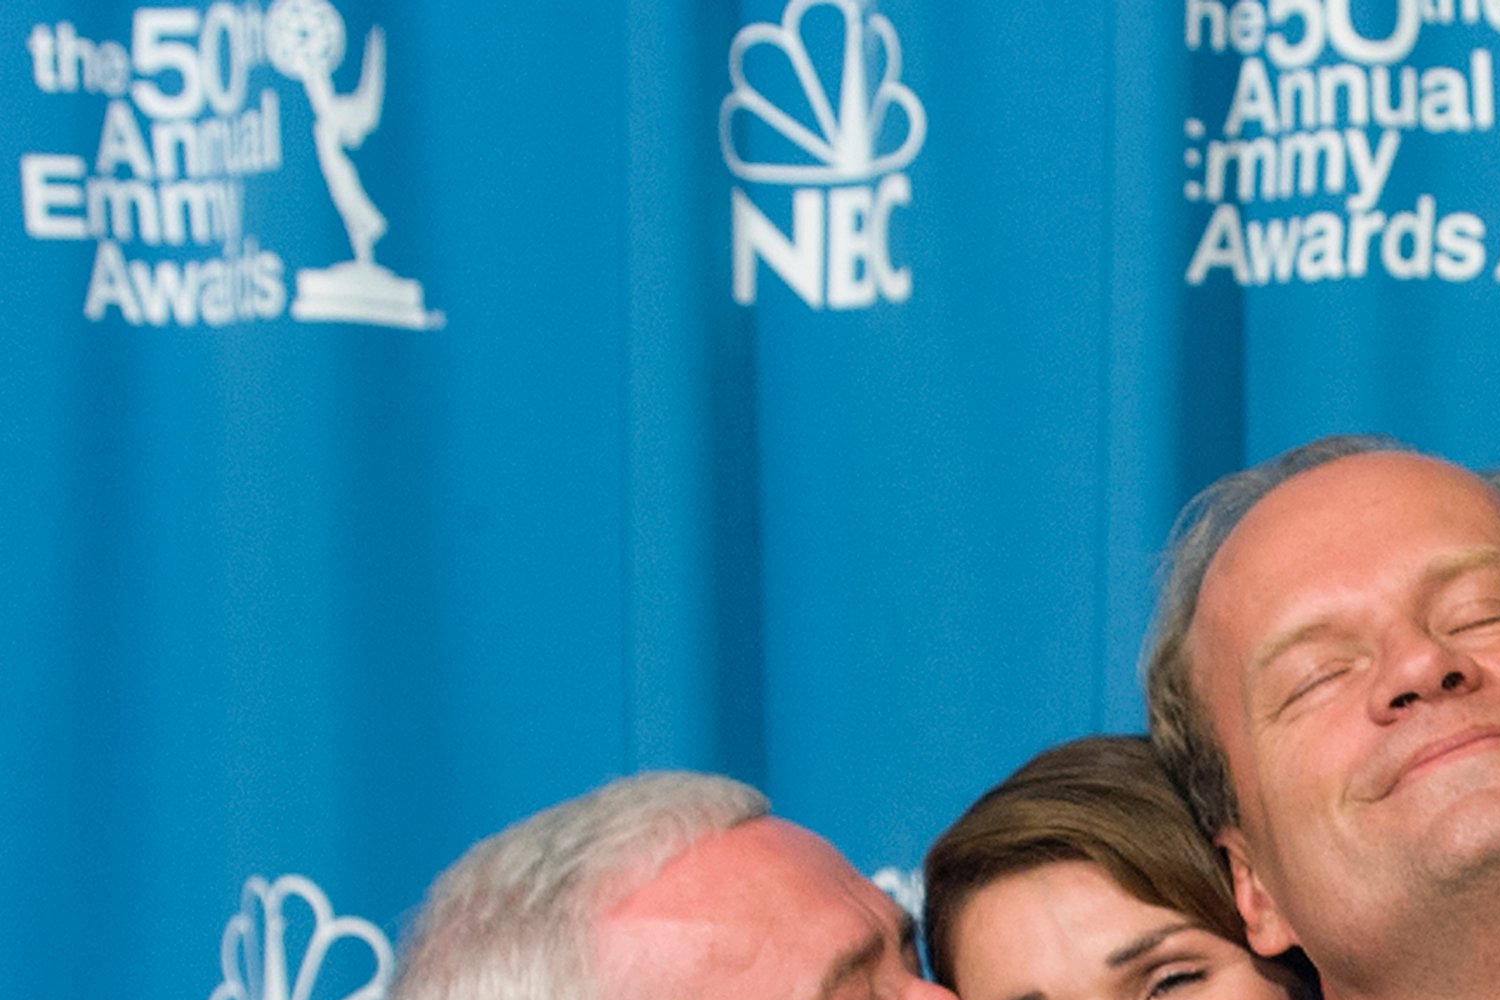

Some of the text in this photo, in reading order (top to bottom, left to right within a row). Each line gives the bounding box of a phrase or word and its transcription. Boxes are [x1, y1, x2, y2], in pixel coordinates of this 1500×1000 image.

[1184, 0, 1266, 53] he
[1223, 48, 1496, 136] Annual
[1184, 118, 1400, 213] mmy
[732, 171, 912, 310] NBC
[1184, 194, 1487, 286] Awards
